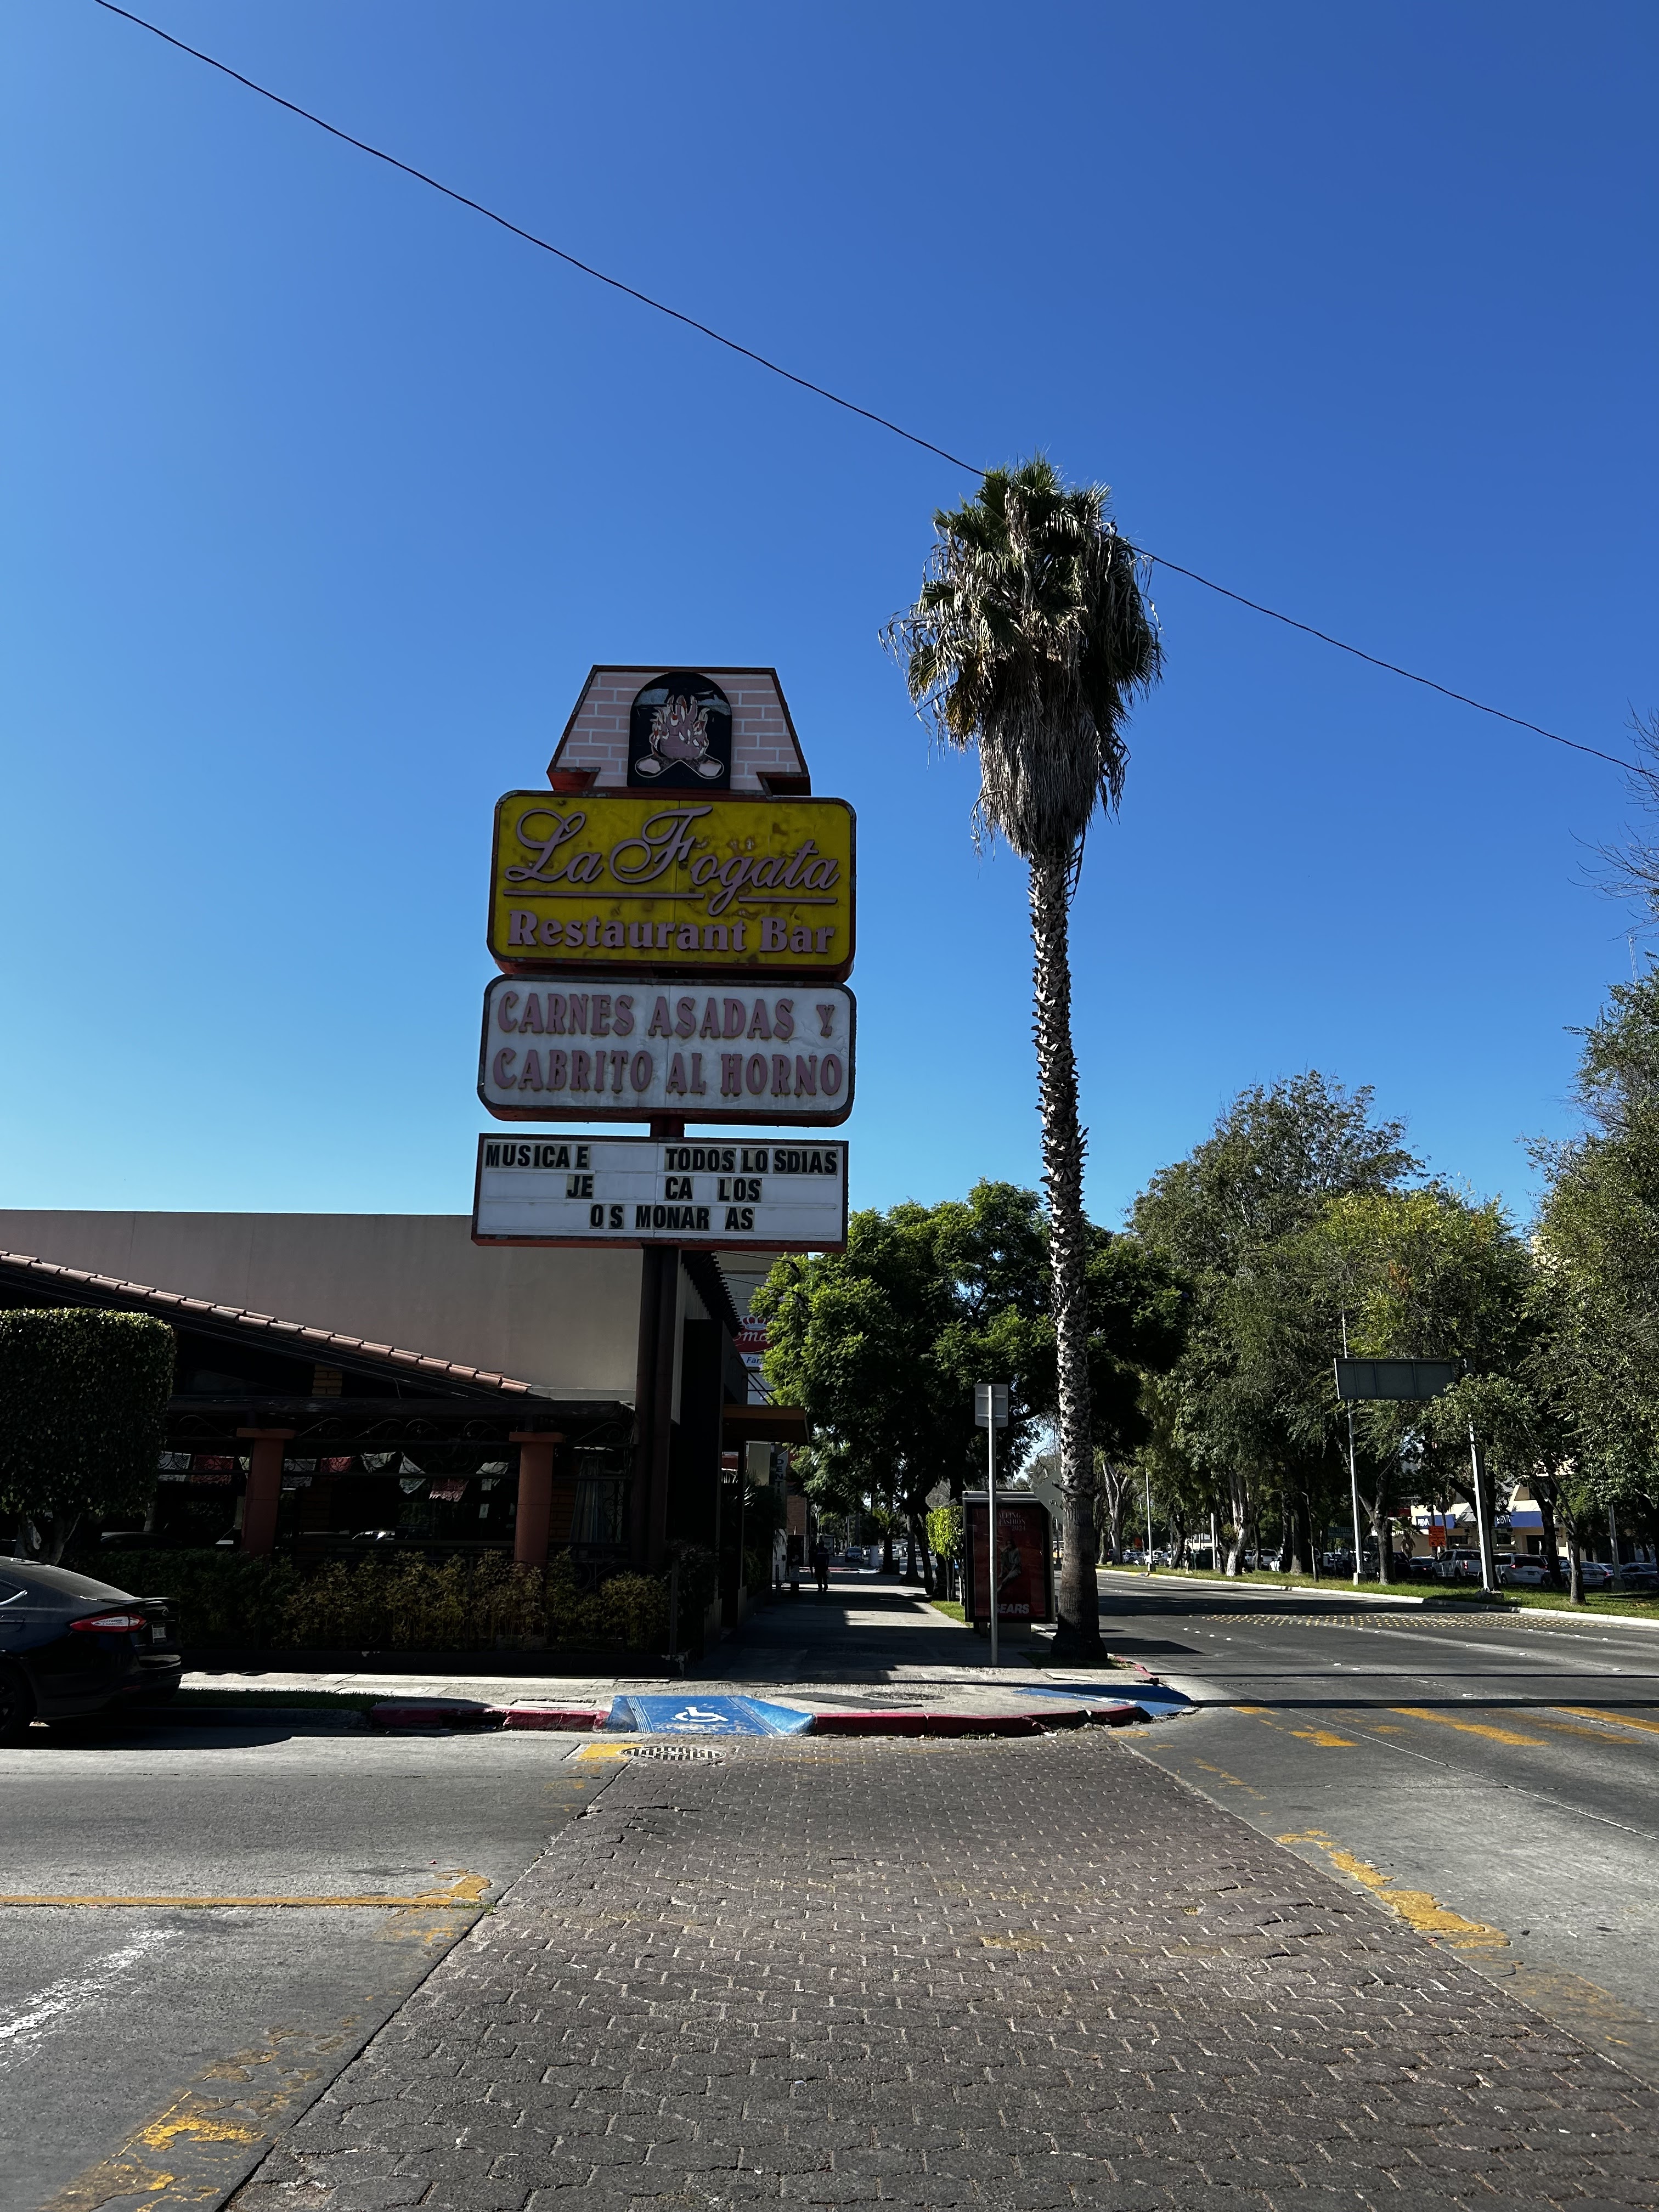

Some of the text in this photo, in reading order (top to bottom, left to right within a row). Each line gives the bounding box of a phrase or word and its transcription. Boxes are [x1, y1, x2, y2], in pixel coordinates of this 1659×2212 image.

[504, 805, 840, 916] La Fogata
[507, 910, 834, 953] Restaurant Bar
[498, 991, 834, 1039] CARNES ASADAS Y
[493, 1047, 842, 1097] CABRITO AL HORNO
[665, 1148, 734, 1172] TODOS
[567, 1175, 760, 1201] JE CA LOS
[636, 1206, 709, 1229] MONAR
[725, 1207, 753, 1230] AS
[775, 1459, 784, 1502] DENTIS
[1496, 1515, 1511, 1524] BBVA
